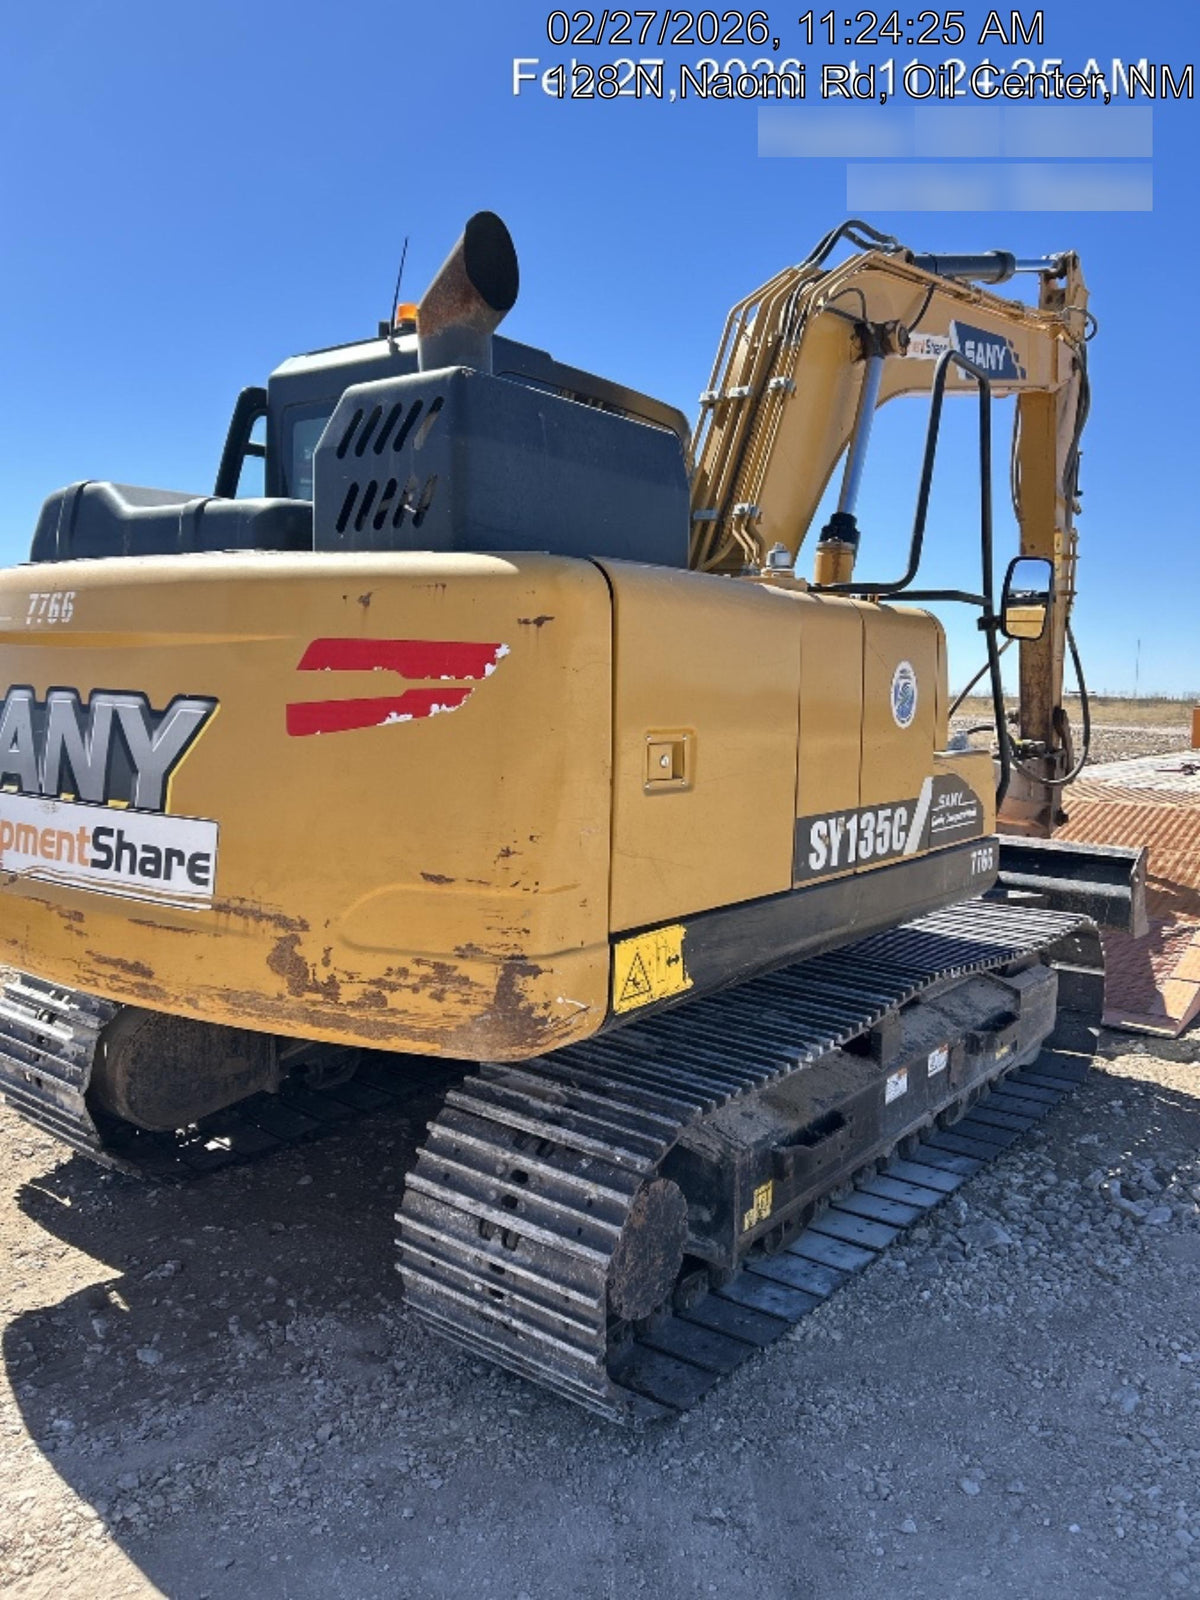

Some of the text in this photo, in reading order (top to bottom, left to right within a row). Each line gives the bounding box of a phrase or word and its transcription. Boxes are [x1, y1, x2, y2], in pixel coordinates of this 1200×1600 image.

[965, 339, 1006, 371] SANY
[26, 591, 76, 624] 7766
[0, 684, 220, 813] ANY
[808, 806, 909, 870] SY135C
